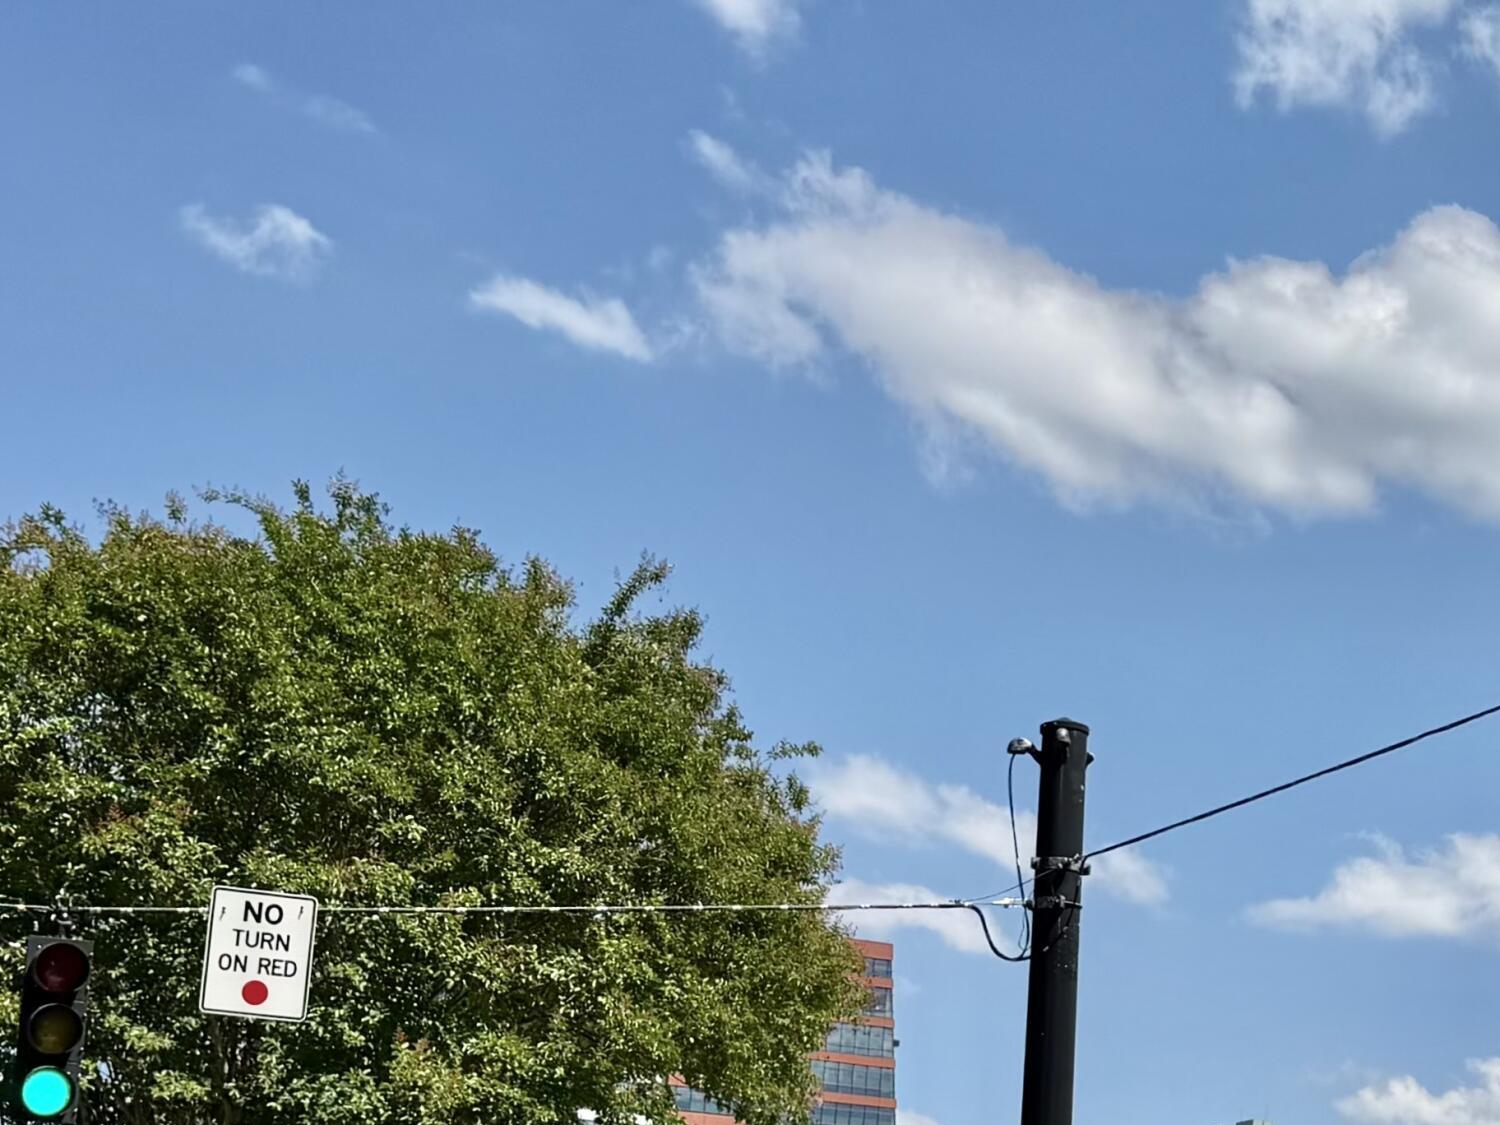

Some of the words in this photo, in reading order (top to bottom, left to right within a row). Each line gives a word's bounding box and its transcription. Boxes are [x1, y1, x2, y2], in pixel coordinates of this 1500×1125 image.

[243, 900, 284, 925] NO
[232, 928, 291, 952] TURN
[218, 953, 248, 973] ON
[257, 957, 298, 978] RED
